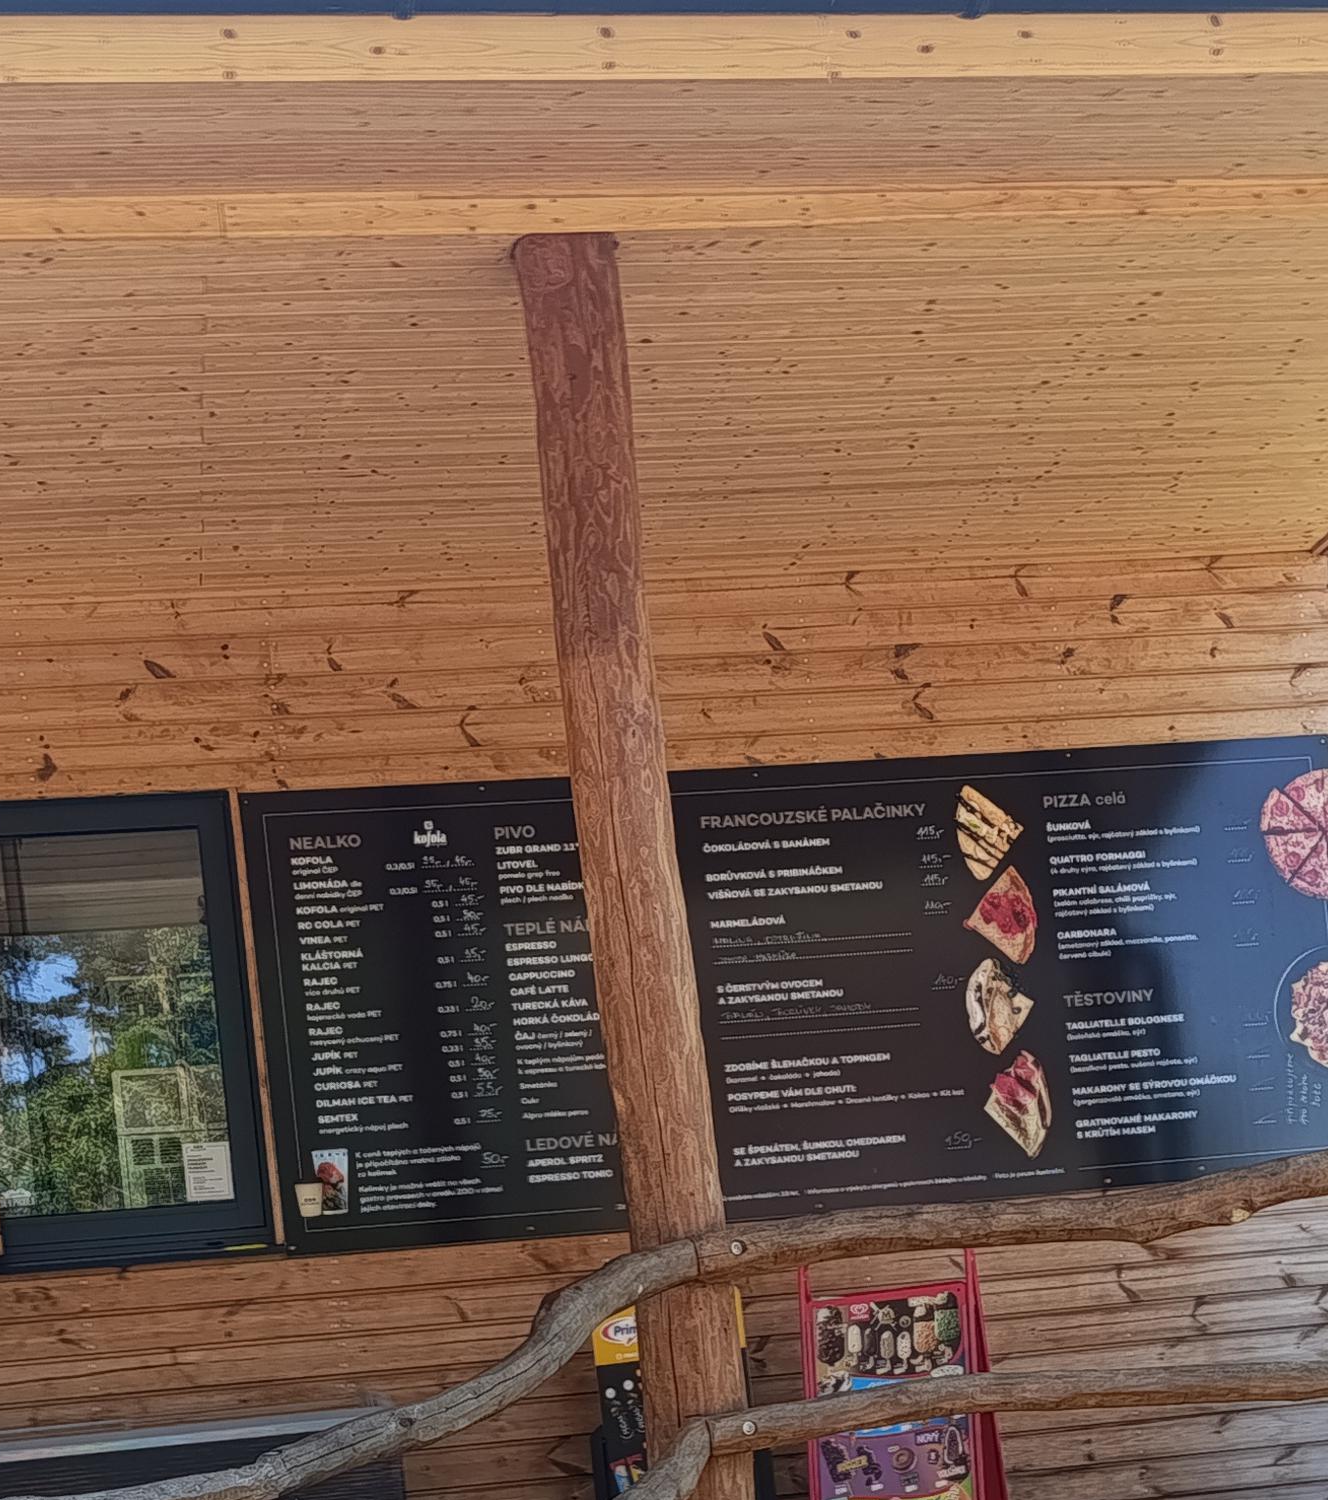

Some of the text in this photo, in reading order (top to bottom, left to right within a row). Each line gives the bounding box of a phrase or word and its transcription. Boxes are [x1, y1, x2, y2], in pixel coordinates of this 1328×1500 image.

[1043, 791, 1126, 808] PIZZA celá
[700, 803, 925, 828] FRANCOUZSKÉ PALAČINKY
[494, 825, 535, 840] PIVO
[1046, 820, 1091, 832] ŠUNKOVÁ
[289, 834, 361, 850] NEALKO
[414, 830, 447, 847] kofola
[703, 839, 771, 853] ČOKOLÁDOVÁ
[773, 841, 780, 849] S
[781, 837, 830, 848] BANÁNEM
[496, 846, 523, 855] ZUBR
[525, 844, 561, 853] GRAND
[291, 856, 333, 865] KOFOLA
[1049, 850, 1146, 865] QUATTRO FORMAGGI
[497, 860, 538, 870] LITOVEL
[706, 869, 767, 882] BORŮVKOVÁ
[768, 870, 775, 878] S
[777, 865, 843, 877] PRIBINÁČKEM
[293, 878, 348, 890] LIMONÁDA
[500, 885, 524, 894] PIVO
[526, 884, 545, 893] DLE
[707, 881, 883, 899] VIŠŇOVÁ SE ZAKYSANOU SMETANOU
[1053, 881, 1150, 897] PIKANTNÍ SALÁMOVÁ
[296, 905, 338, 915] KOFOLA
[339, 905, 368, 914] original
[314, 920, 344, 929] COLA
[504, 917, 556, 936] TEPLÉ
[710, 915, 786, 928] MARMELÁDOVÁ
[299, 936, 331, 944] VINEA
[1057, 928, 1117, 940] CARBONARA
[505, 941, 557, 951] ESPRESSO
[301, 948, 363, 961] KLÁŠTORNÁ
[507, 956, 558, 966] ESPRESSO
[302, 962, 341, 971] KALCIA
[303, 977, 337, 986] RAJEC
[509, 970, 575, 981] CAPPUCCINO
[510, 985, 569, 996] CAFÉ LATTE
[717, 985, 724, 993] S
[725, 980, 779, 993] ČERSTVÝM
[780, 979, 823, 989] OVOCEM
[511, 997, 588, 1010] TURECKÁ KÁVA
[718, 989, 843, 1005] A ZAKYSANOU SMETANOU
[1063, 989, 1153, 1007] TĚSTOVINY
[306, 1001, 340, 1011] RAJEC
[513, 1014, 549, 1026] HORKÁ
[1065, 1013, 1185, 1030] TAGLIATELLE BOLOGNESE
[308, 1026, 343, 1036] RAJEC
[515, 1031, 535, 1040] ČAJ
[312, 1050, 341, 1061] JUPÍK
[1069, 1048, 1160, 1063] TAGLIATELLE PESTO
[724, 1061, 769, 1072] ZDOBÍME
[771, 1057, 829, 1069] ŠLEHAČKOU
[840, 1053, 890, 1063] TOPINGEM
[313, 1065, 343, 1076] JUPÍK
[314, 1081, 361, 1091] CURIOSA
[363, 1080, 378, 1088] PET
[1072, 1074, 1236, 1095] MAKARONY SE SÝROVOU OMÁČKOU
[727, 1090, 780, 1101] POSYPEME
[781, 1087, 803, 1097] VÁM
[804, 1087, 823, 1096] DLE
[316, 1098, 356, 1108] DILMAH
[357, 1096, 375, 1105] ICE
[376, 1095, 397, 1103] TEA
[318, 1113, 358, 1124] SEMTEX
[1075, 1110, 1198, 1128] GRATINOVANÉ MAKARONY
[1077, 1125, 1156, 1139] S KRŮTÍM MASEM
[526, 1131, 595, 1151] LEDOVÉ
[733, 1147, 746, 1155] SE
[846, 1135, 906, 1147] CHEDDAREM
[527, 1154, 604, 1167] APEROL SPRITZ
[743, 1154, 805, 1166] ZAKYSANOU
[806, 1150, 859, 1161] SMETANOU
[528, 1169, 613, 1183] ESPRESSO TONIC
